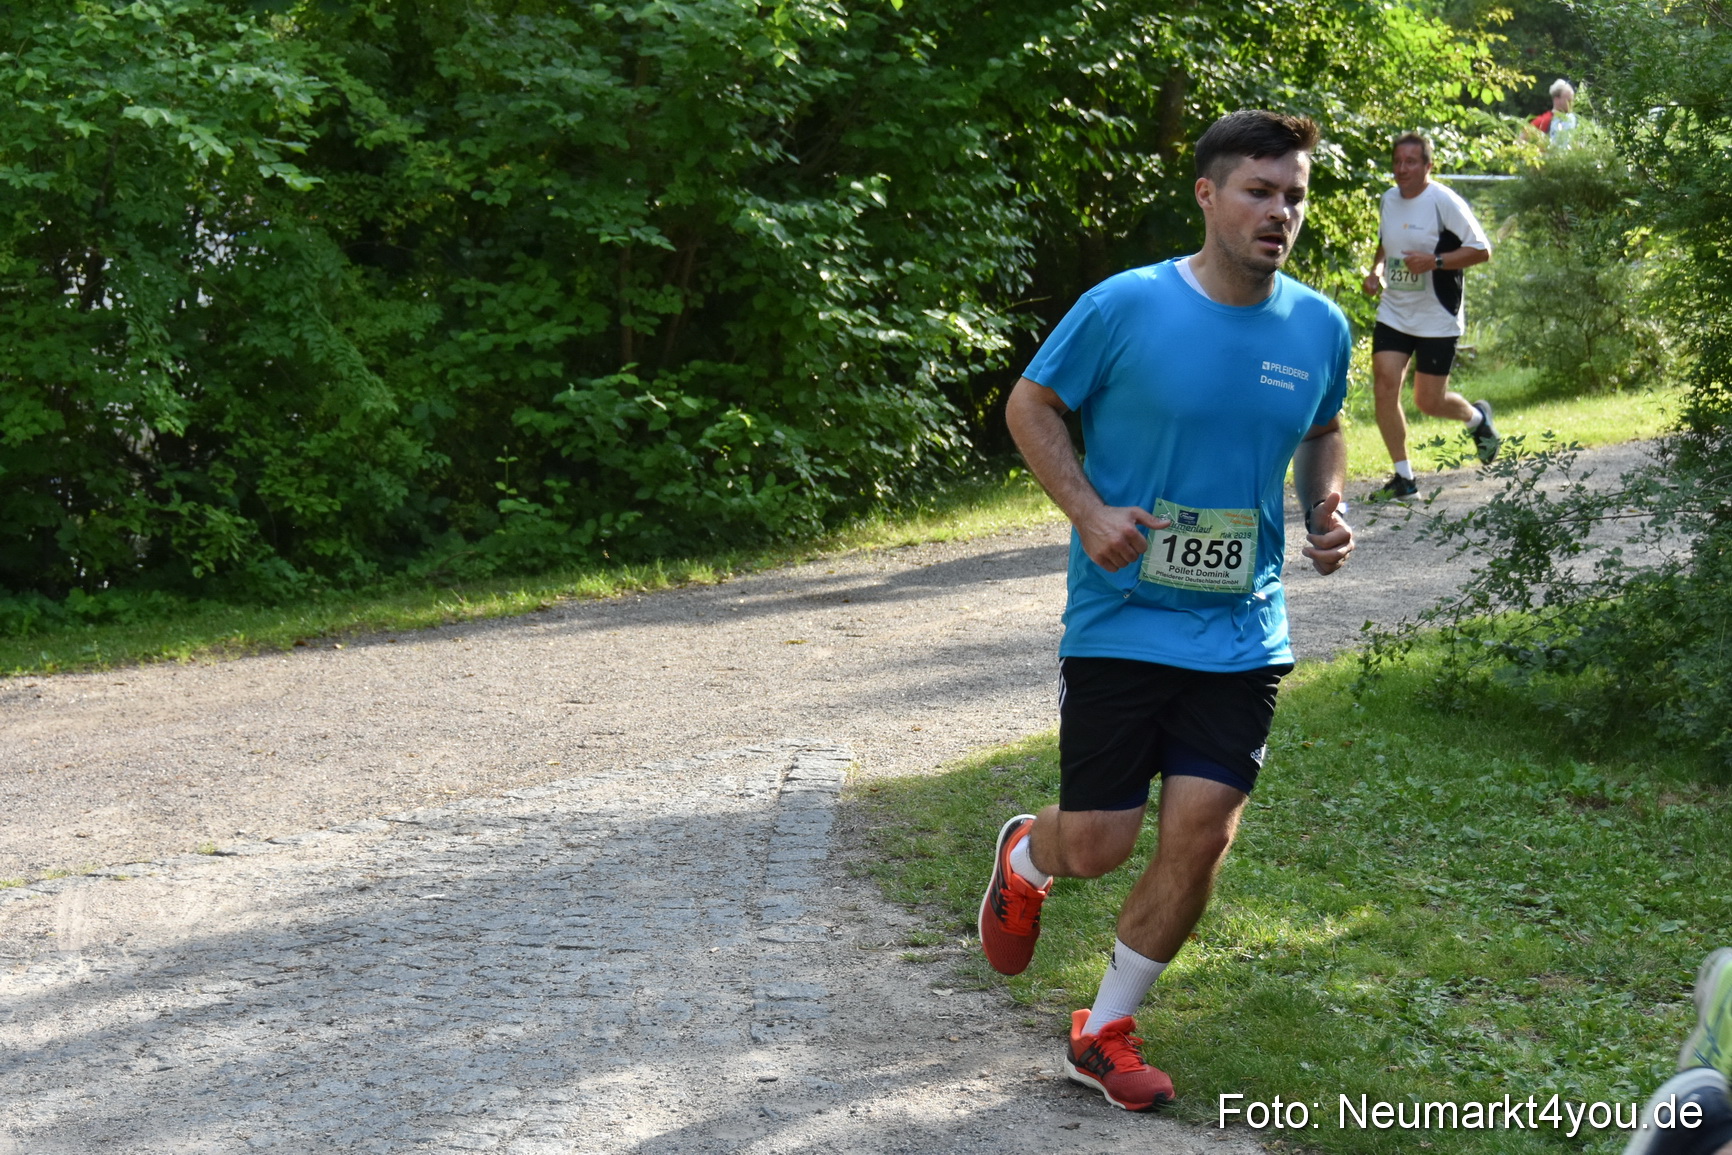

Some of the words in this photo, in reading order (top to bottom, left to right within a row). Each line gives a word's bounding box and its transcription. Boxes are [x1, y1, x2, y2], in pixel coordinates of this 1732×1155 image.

[1270, 363, 1309, 381] PFLEIDERER
[1260, 375, 1295, 391] Dominik
[1162, 534, 1243, 570] 1858
[1155, 570, 1184, 581] Pfleiderer
[1184, 576, 1220, 585] Deutschland
[1168, 565, 1194, 576] Pöllet
[1195, 569, 1230, 578] Dominik
